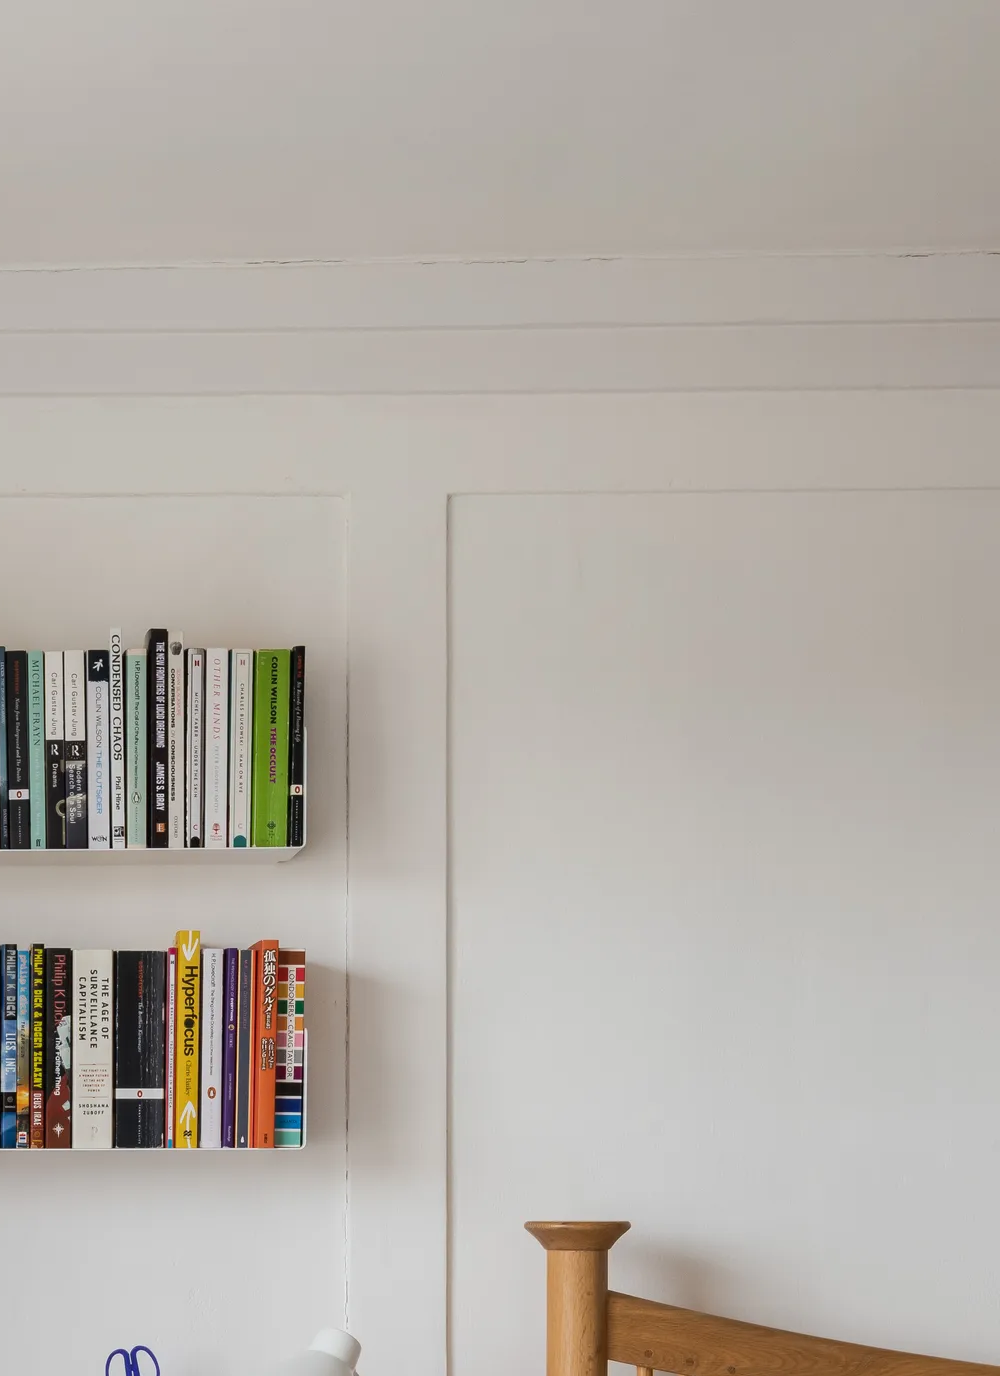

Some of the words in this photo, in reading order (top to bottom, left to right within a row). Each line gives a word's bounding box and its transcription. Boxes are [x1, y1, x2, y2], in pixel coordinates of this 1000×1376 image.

[156, 642, 165, 652] THE
[156, 653, 165, 665] NEW
[111, 635, 121, 711] CONDENSED
[156, 667, 165, 695] FRONTIERS
[213, 659, 221, 697] OTHER
[156, 704, 165, 719] LUCID
[213, 703, 221, 740] MINDS
[33, 712, 41, 746] FRAYN
[113, 717, 122, 760] CHAOS
[156, 720, 165, 748] DREAMING
[156, 762, 165, 784] JAMES
[156, 793, 164, 811] BRAY
[34, 948, 43, 975] PHILIP
[52, 954, 66, 986] Philip
[101, 978, 109, 997] THE
[263, 949, 276, 1013] 孤独のグルメ
[34, 990, 42, 1008] DICK
[90, 969, 98, 1048] SURVEILLANCE
[101, 1002, 109, 1022] AGE
[54, 1001, 66, 1026] Dick
[34, 1021, 43, 1048] ROGER
[102, 1027, 109, 1040] OF
[34, 1051, 43, 1088] ZELAZNY
[34, 1093, 42, 1109] DEUS
[34, 1112, 42, 1126] IRAE
